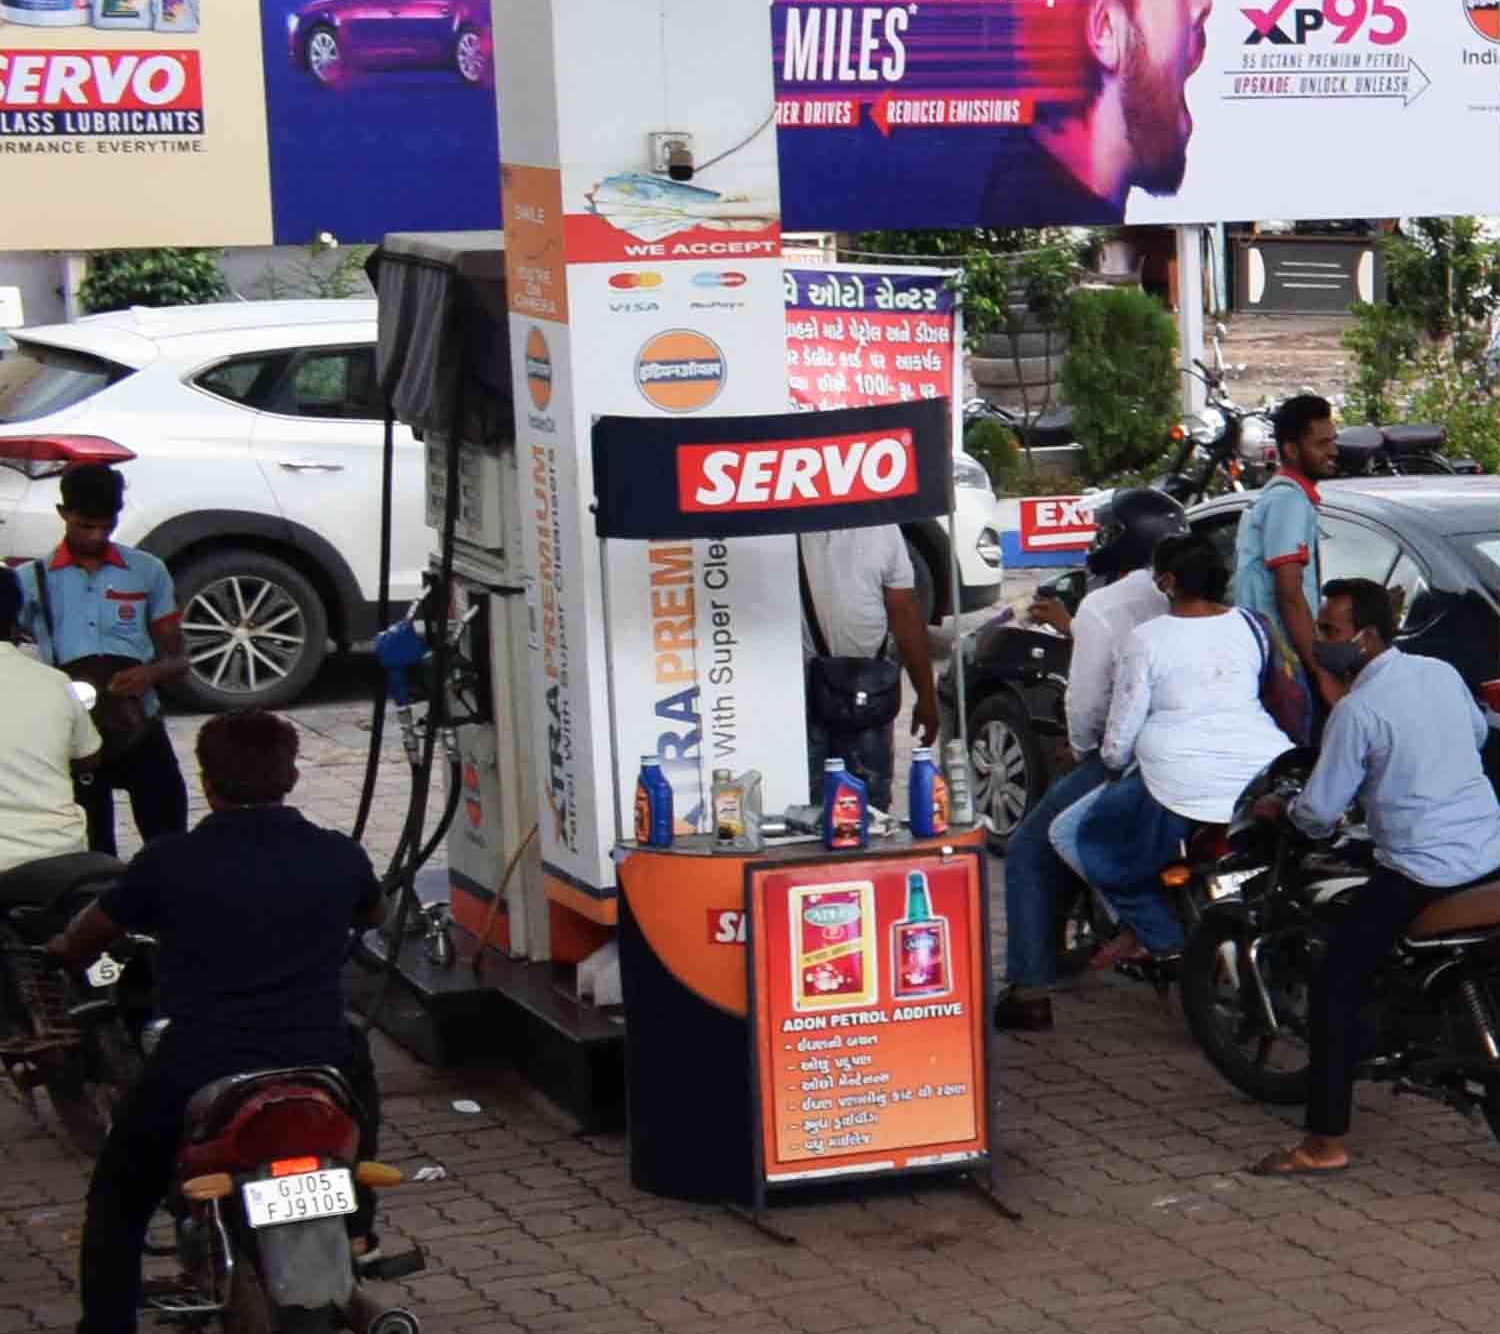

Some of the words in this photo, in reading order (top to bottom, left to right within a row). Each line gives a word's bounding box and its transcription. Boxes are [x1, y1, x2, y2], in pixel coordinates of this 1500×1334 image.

[1261, 53, 1302, 69] OCTANE
[1307, 53, 1361, 68] PREMIUM
[1366, 52, 1406, 68] PETROL
[0, 55, 186, 106] ERVO
[0, 112, 56, 134] LASS
[65, 111, 201, 134] LUBRICANTS
[803, 101, 852, 124] DRIVES
[887, 99, 945, 123] REDUCED
[948, 99, 1021, 123] EMISSIONS
[625, 243, 665, 257] WE
[671, 239, 776, 255] ACCEPT
[608, 301, 661, 313] VISA
[695, 438, 908, 505] SERVO
[708, 601, 738, 685] Super
[711, 695, 737, 758] With
[783, 1016, 827, 1032] ADON
[831, 1010, 889, 1028] PETROL
[892, 1002, 963, 1021] ADDITIVE
[279, 1173, 332, 1198] GJ05
[266, 1191, 350, 1220] FJ9105
